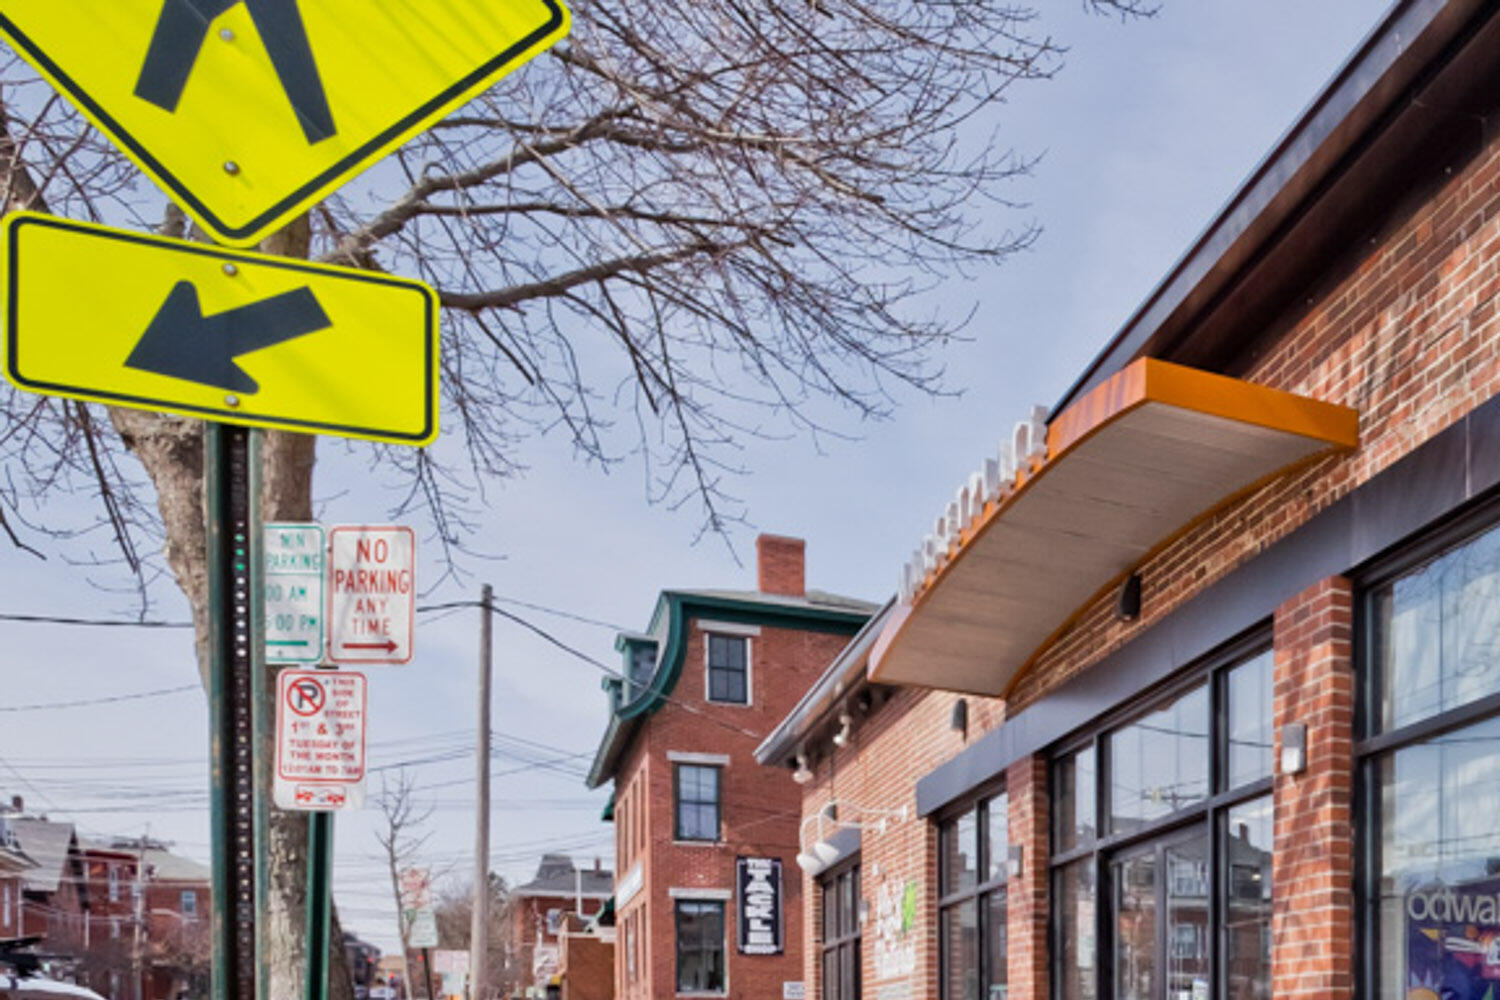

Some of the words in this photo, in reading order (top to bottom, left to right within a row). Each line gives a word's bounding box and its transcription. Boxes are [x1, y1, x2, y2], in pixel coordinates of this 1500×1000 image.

[357, 539, 388, 563] NO
[335, 570, 409, 594] PARKING
[356, 599, 388, 614] ANY
[353, 618, 391, 635] TIME
[744, 868, 775, 944] TACKLE
